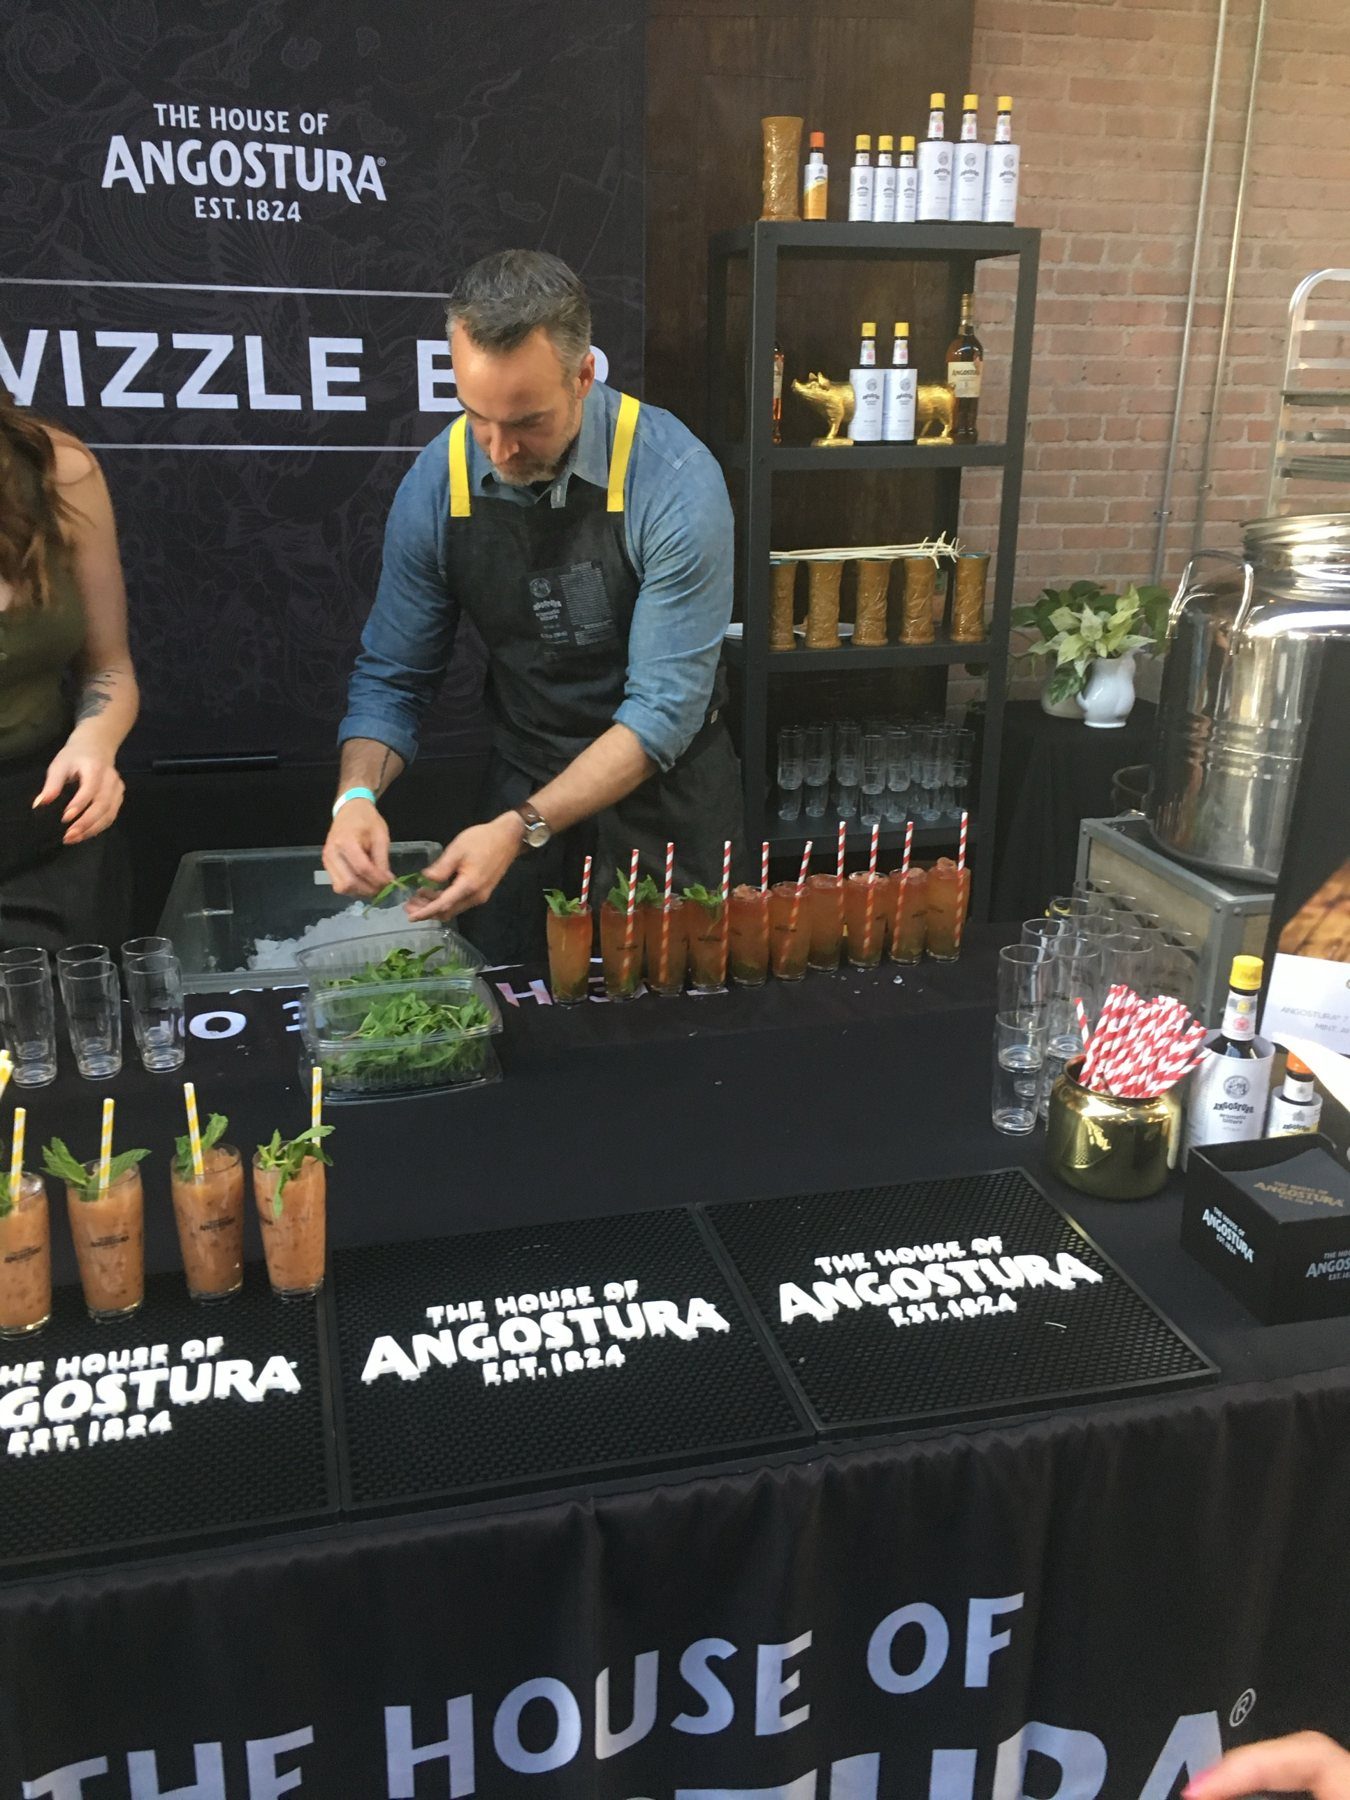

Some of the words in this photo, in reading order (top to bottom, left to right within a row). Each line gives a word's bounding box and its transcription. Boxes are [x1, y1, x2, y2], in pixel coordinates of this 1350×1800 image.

[153, 103, 200, 129] THE
[209, 106, 290, 134] HOUSE
[299, 112, 329, 135] OF
[814, 1252, 872, 1276] THE
[875, 1241, 967, 1266] HOUSE
[971, 1235, 1003, 1256] OF
[426, 1300, 486, 1327] THE
[495, 1286, 595, 1316] HOUSE
[603, 1279, 638, 1303] OF
[779, 1252, 1103, 1325] ANGOSTURA
[55, 1344, 169, 1382] HOUSE
[181, 1336, 224, 1363] OF
[361, 1297, 730, 1385] ANGOSTURA
[384, 1630, 813, 1800] HOUSE
[866, 1592, 1025, 1694] OF
